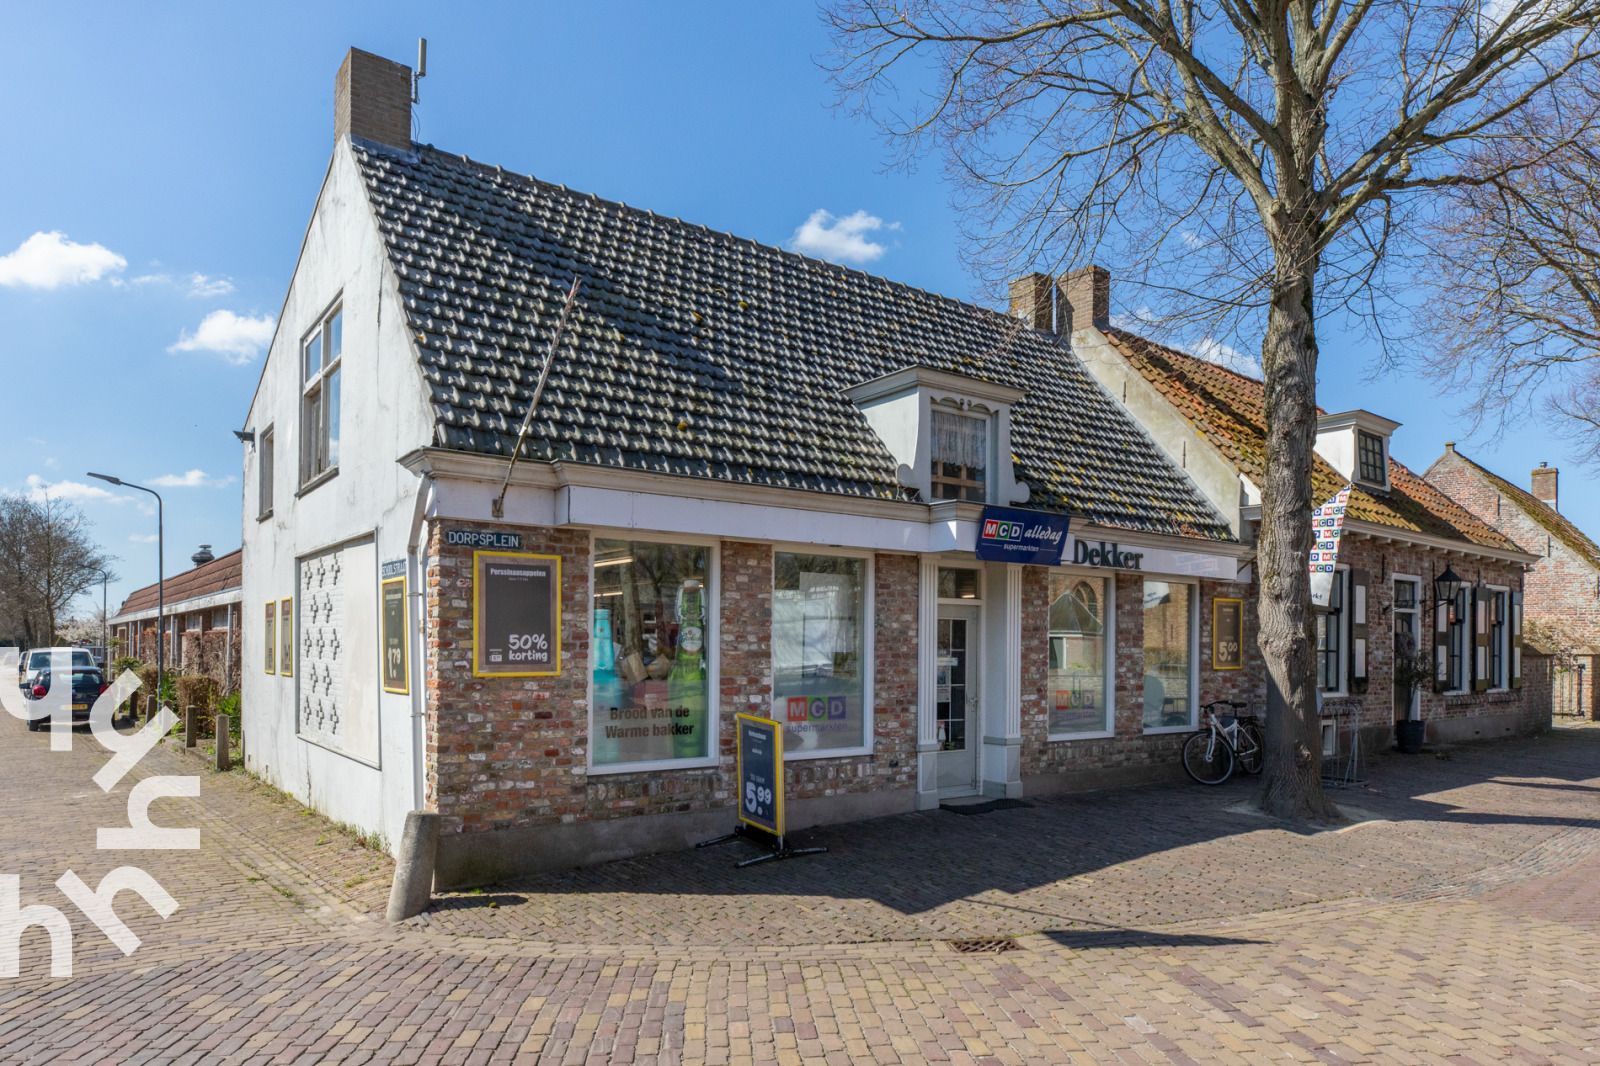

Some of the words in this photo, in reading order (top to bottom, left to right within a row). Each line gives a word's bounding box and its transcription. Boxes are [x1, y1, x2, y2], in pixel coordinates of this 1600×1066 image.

[448, 531, 520, 547] DORPSPLEIN
[983, 519, 1022, 540] MCD
[1024, 525, 1063, 545] alledag
[1074, 539, 1144, 571] Dekker
[508, 633, 548, 649] 50%
[508, 649, 548, 662] korting
[610, 708, 648, 721] Brood
[650, 708, 672, 720] van
[674, 705, 690, 718] de
[788, 697, 846, 721] MCD
[605, 725, 649, 739] Warme
[652, 723, 694, 737] bakker
